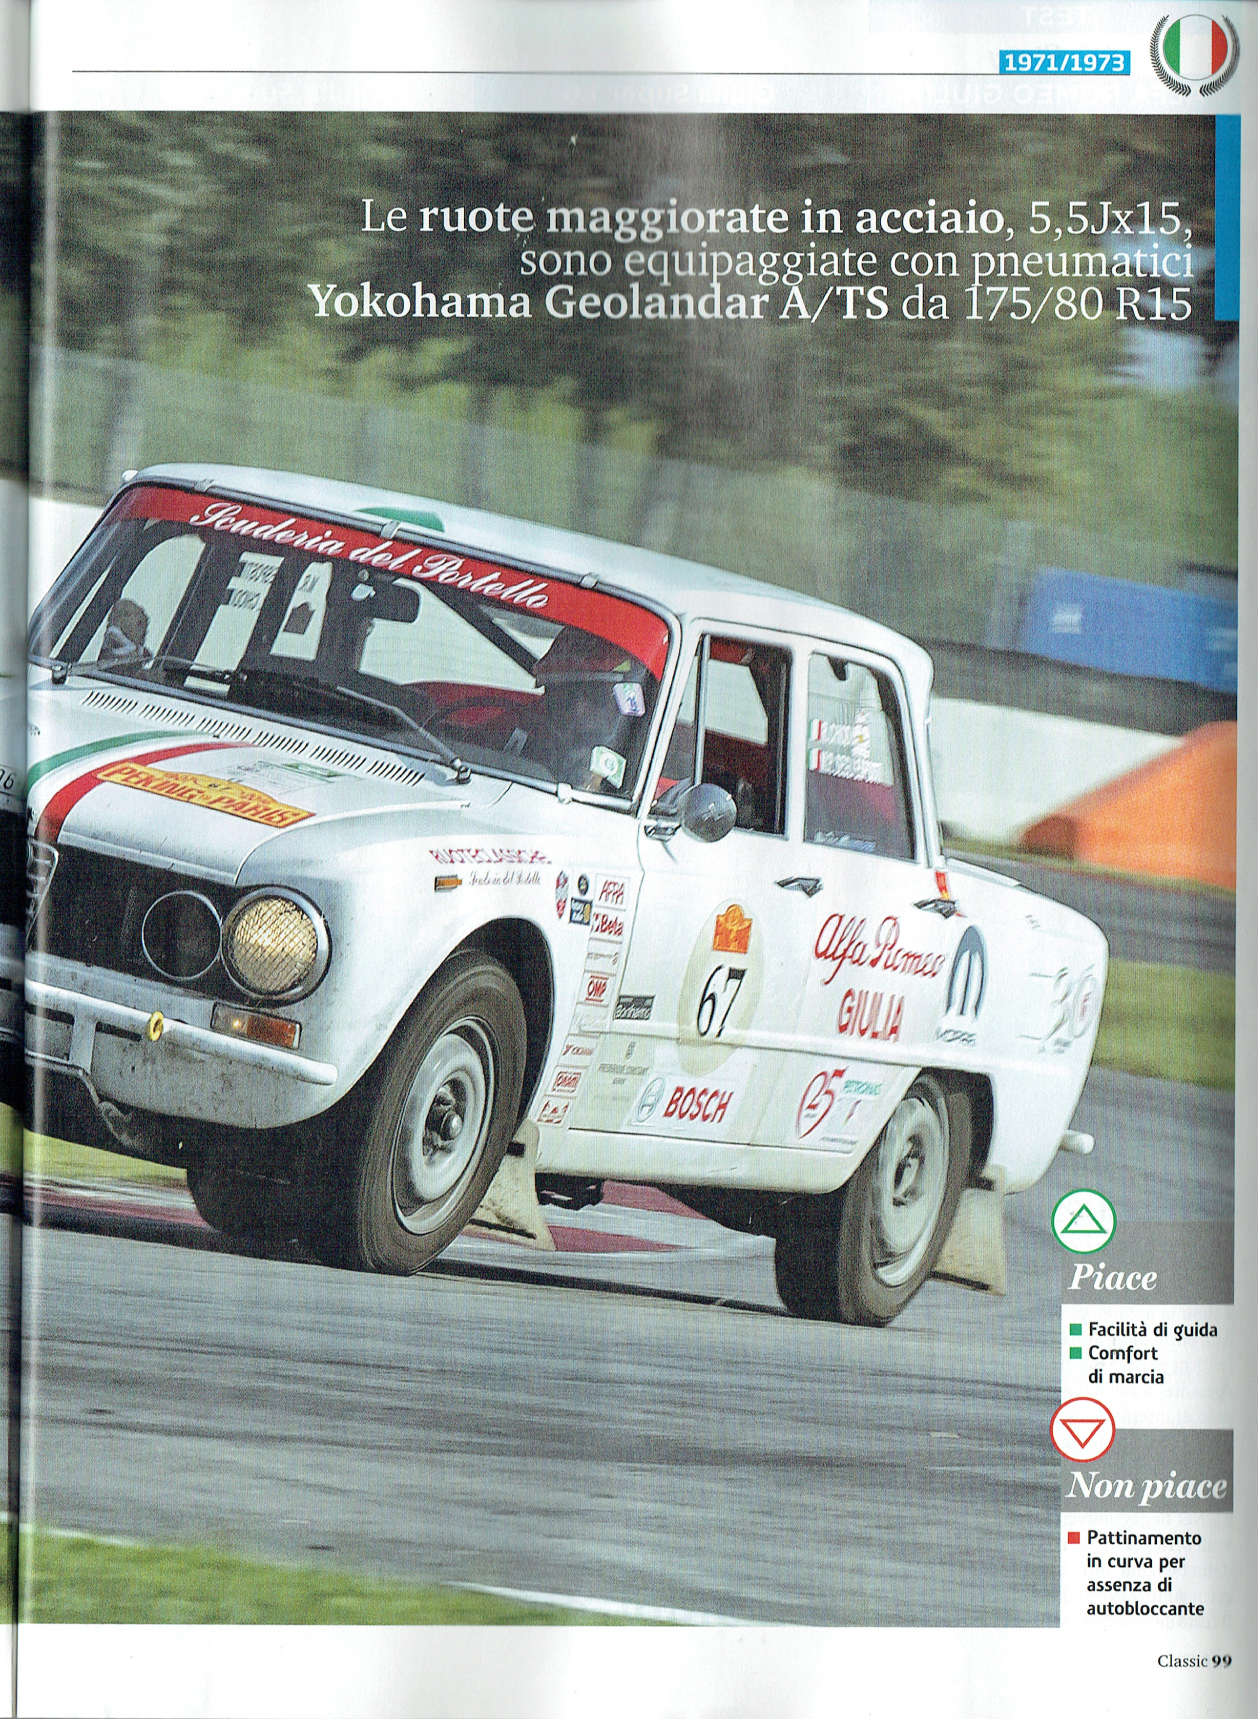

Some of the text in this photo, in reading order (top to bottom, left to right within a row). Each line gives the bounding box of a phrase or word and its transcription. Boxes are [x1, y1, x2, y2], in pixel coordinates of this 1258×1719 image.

[1005, 53, 1125, 72] 1971/1973
[361, 197, 1194, 243] Le ruote maggiorate in acciaio, 5,5Jx15,
[520, 241, 1195, 288] sono equipaggiate con pneumatici
[307, 281, 1193, 324] Yokohama Geolandar A/TS da 175/80 R15
[189, 502, 550, 609] Scuderia del Portello
[814, 913, 948, 986] Alfa Romeo
[697, 963, 747, 1039] 67
[838, 987, 905, 1042] GIULIA
[663, 1085, 734, 1124] BOSCH
[1066, 1261, 1158, 1291] Piace
[1089, 1320, 1218, 1342] Facilità di guida
[1088, 1345, 1159, 1364] Comfort
[1088, 1368, 1164, 1384] di marcia
[1065, 1470, 1228, 1507] Non piace
[1087, 1529, 1202, 1546] Pattinamento
[1087, 1553, 1186, 1573] in curva per
[1087, 1576, 1172, 1592] assenza di
[1086, 1600, 1205, 1616] autobloccante
[1157, 1653, 1233, 1668] Classic 99
